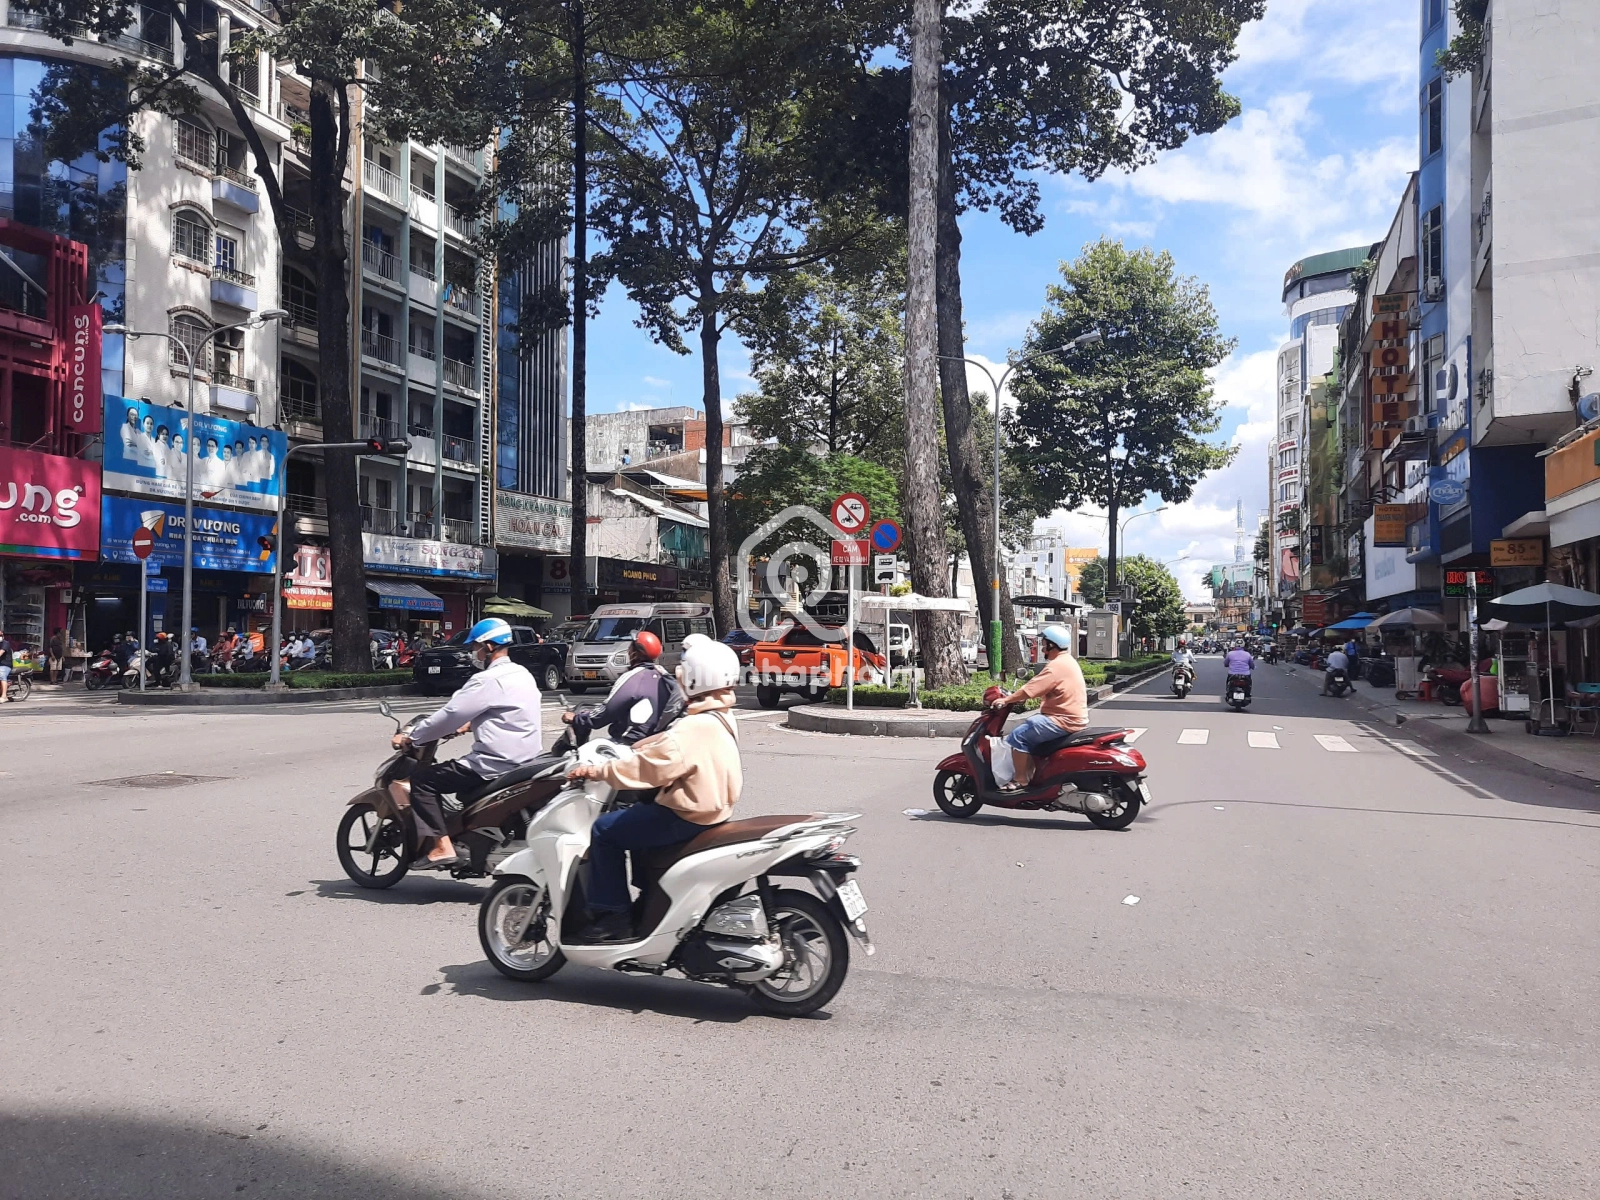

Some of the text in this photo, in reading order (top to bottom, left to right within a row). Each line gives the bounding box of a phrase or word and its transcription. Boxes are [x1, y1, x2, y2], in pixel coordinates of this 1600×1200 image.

[73, 314, 90, 423] concung
[15, 512, 52, 524] .com
[842, 542, 858, 553] CẤM
[1507, 543, 1526, 554] 85
